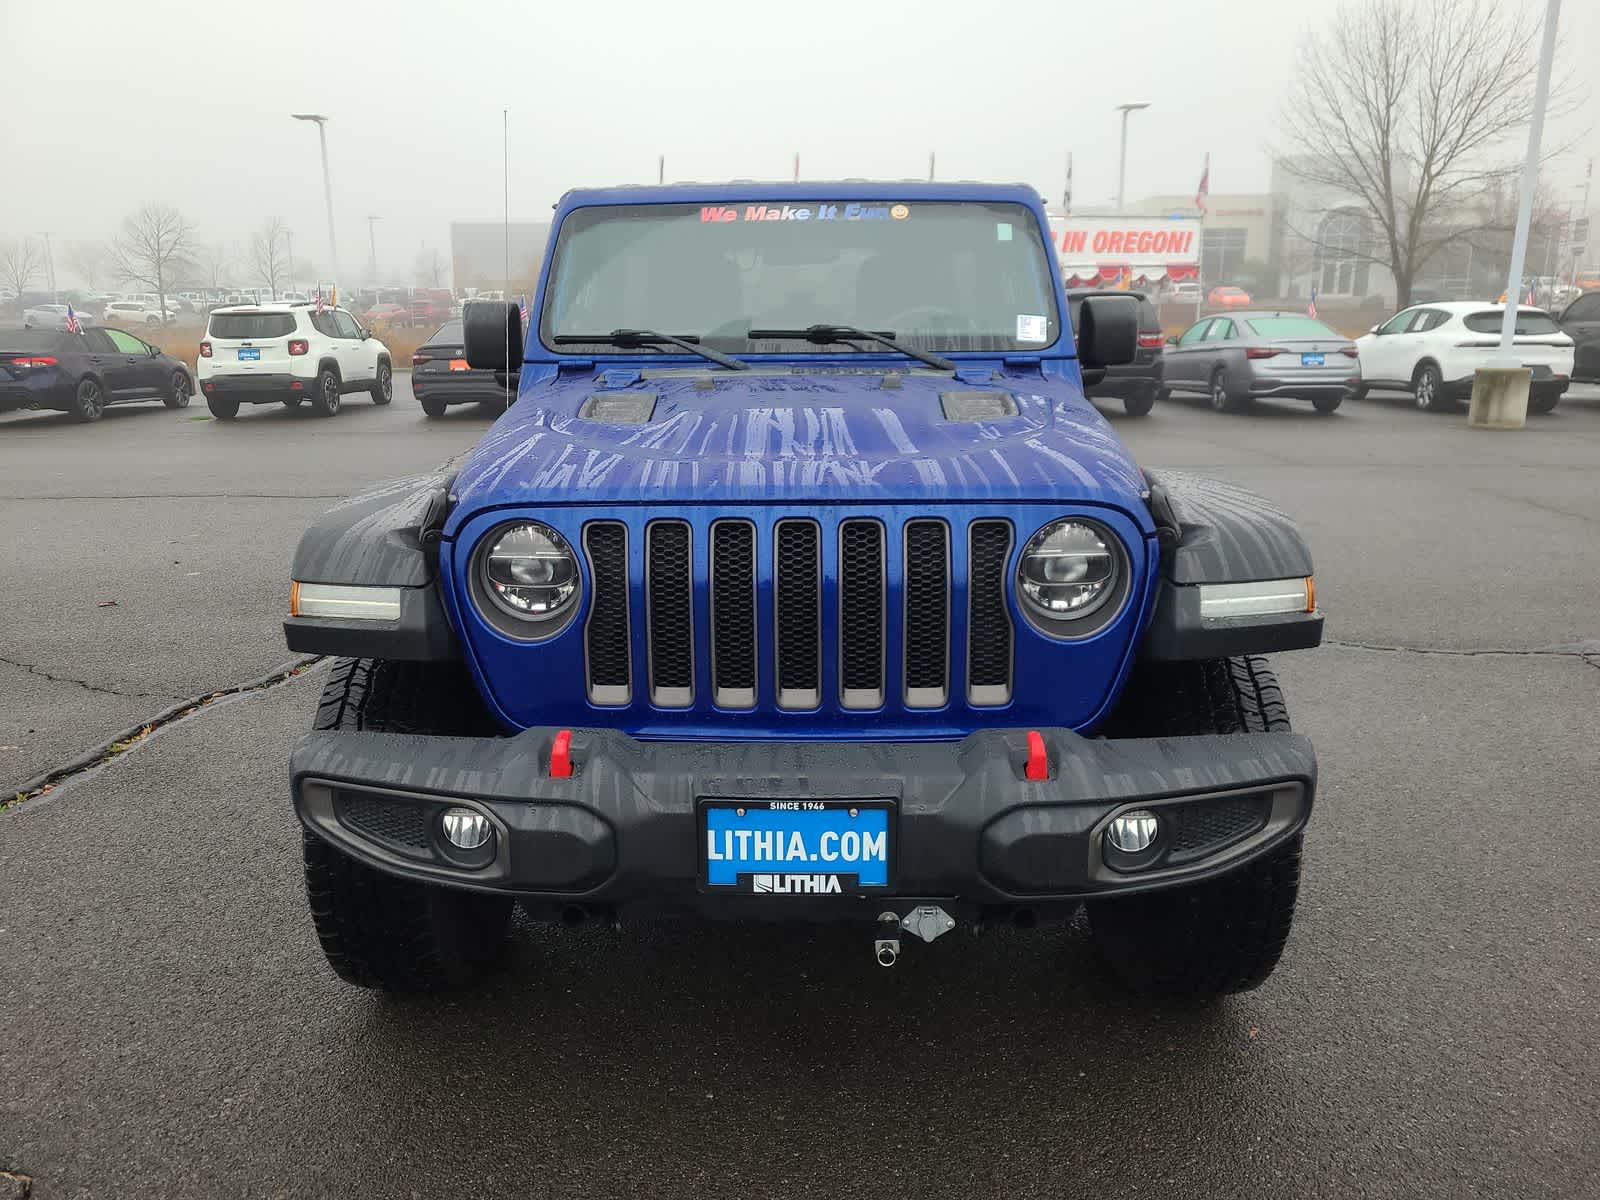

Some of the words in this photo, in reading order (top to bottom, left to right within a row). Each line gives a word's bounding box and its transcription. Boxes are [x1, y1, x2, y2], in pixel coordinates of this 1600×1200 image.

[701, 207, 737, 222] We
[744, 205, 810, 221] Make
[818, 204, 837, 220] It
[1062, 231, 1088, 253] IN
[1093, 231, 1193, 254] OREGON!
[770, 802, 800, 810] SINCE
[803, 802, 825, 810] 1946
[707, 830, 887, 861] LITHIA.COM
[773, 874, 842, 893] LITHIA
